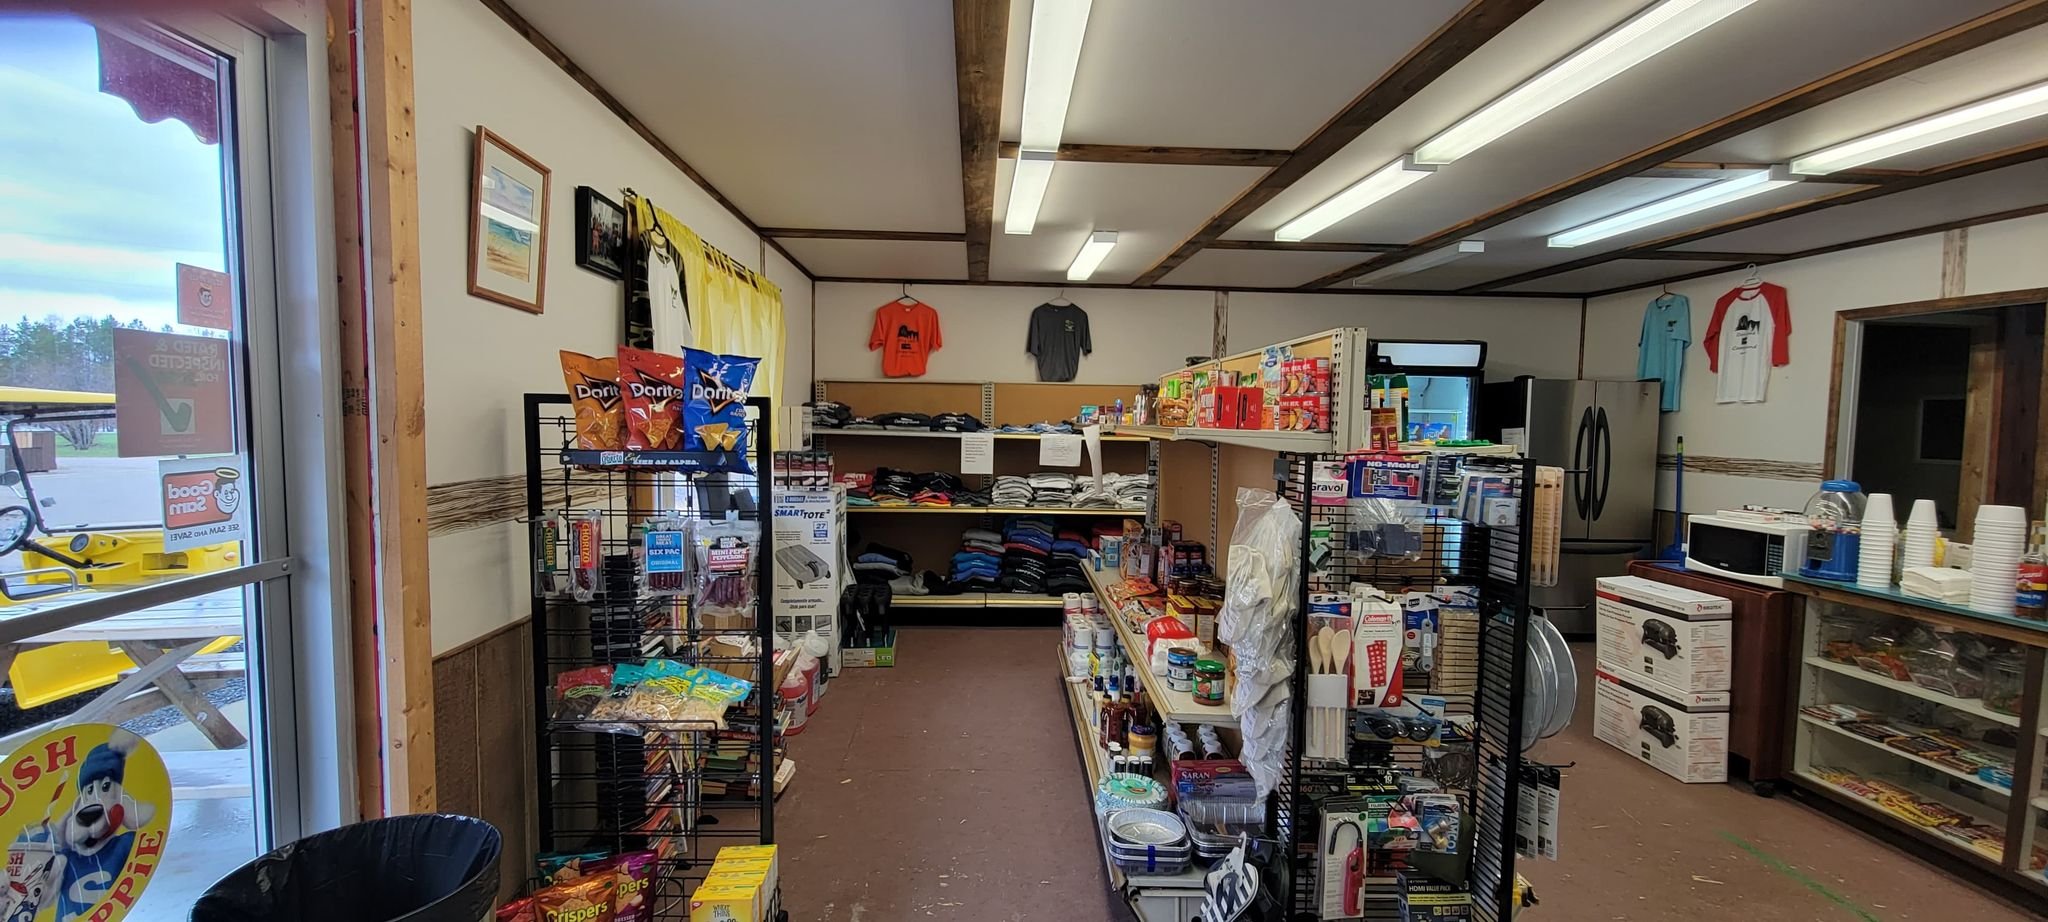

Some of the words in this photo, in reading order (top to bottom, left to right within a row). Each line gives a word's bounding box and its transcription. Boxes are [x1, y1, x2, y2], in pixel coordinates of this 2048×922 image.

[575, 383, 621, 400] Dorit
[630, 382, 683, 400] Dorito
[1312, 483, 1344, 492] Gravol
[774, 508, 805, 517] SMART
[803, 511, 825, 519] TOTE
[582, 523, 591, 563] CHORIZO
[1364, 615, 1387, 623] Coleman
[0, 735, 78, 817] USH
[1181, 771, 1210, 780] SARAN
[616, 877, 650, 899] pers
[546, 901, 608, 922] Crispers
